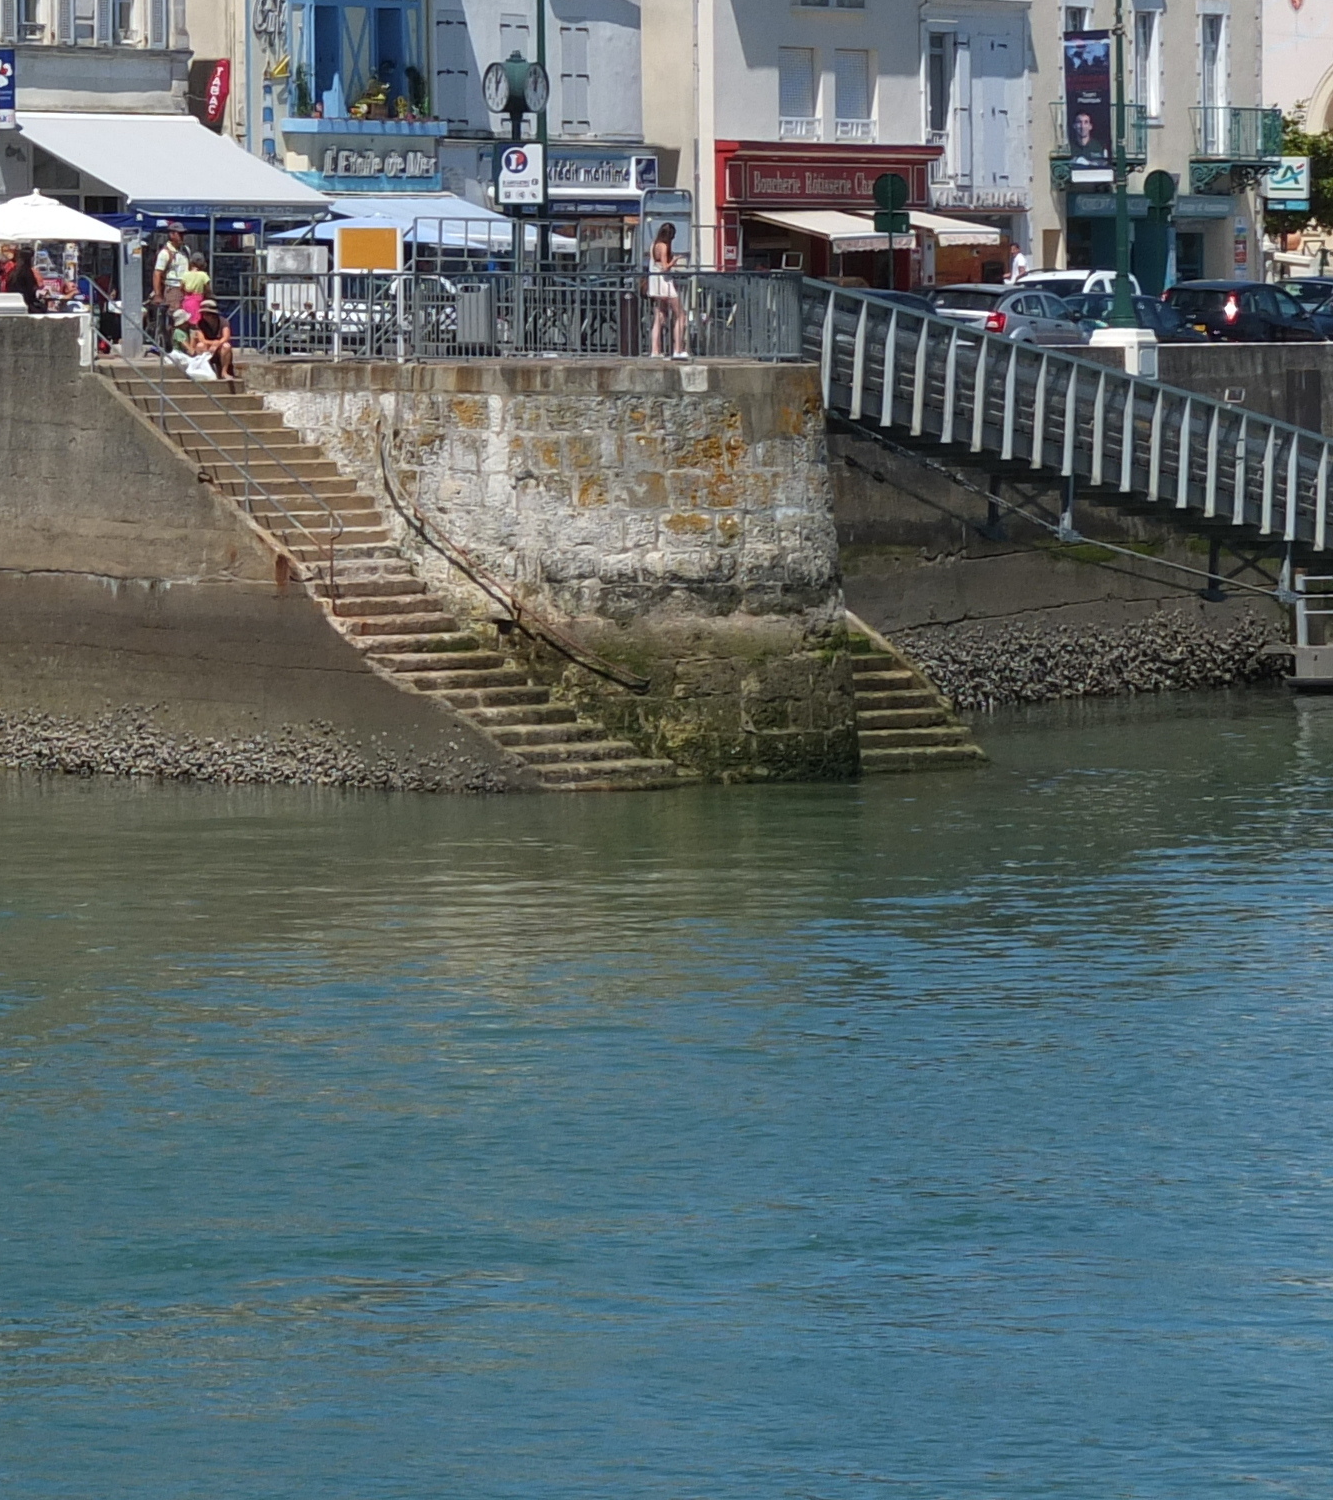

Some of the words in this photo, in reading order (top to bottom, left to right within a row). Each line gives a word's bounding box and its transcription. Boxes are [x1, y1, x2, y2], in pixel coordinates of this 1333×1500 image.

[208, 66, 225, 115] TABAC
[753, 170, 801, 194] Boucherie
[805, 170, 852, 195] Rôtisserie
[854, 171, 875, 195] Char
